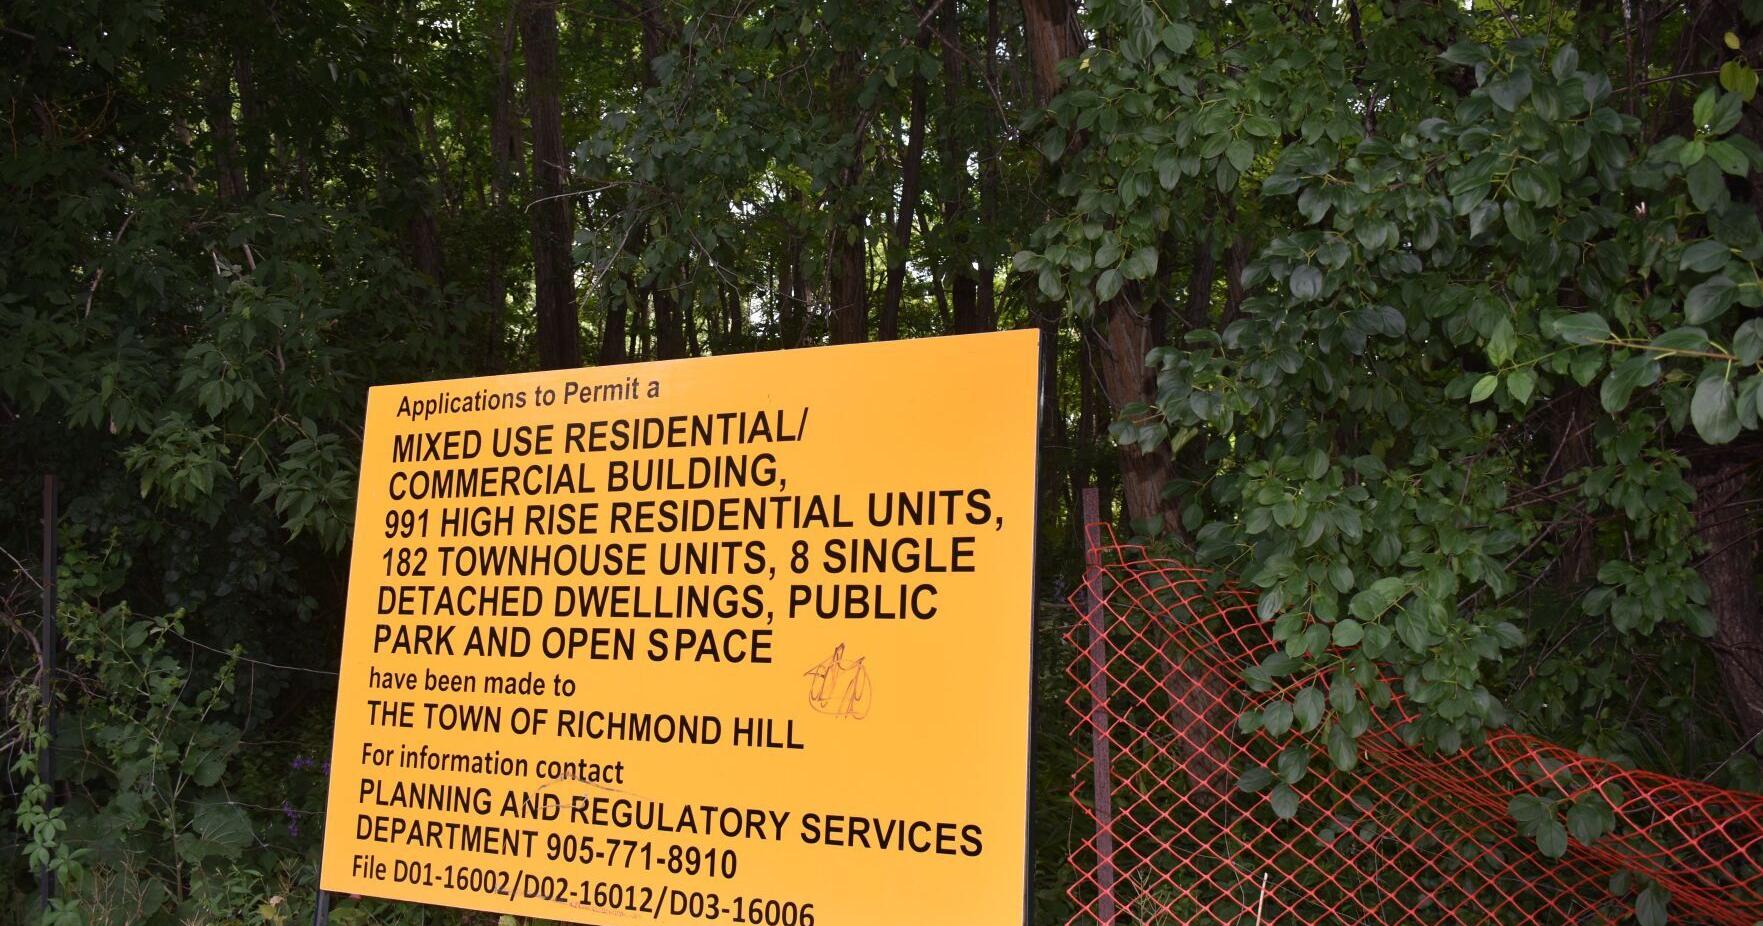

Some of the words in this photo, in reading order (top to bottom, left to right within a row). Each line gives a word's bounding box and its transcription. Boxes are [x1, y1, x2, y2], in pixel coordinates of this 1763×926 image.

[396, 391, 527, 422] Applications
[534, 386, 556, 407] to
[564, 377, 640, 405] Permit
[647, 380, 660, 399] a
[392, 429, 482, 463] MIXED
[492, 424, 554, 458] USE
[564, 407, 809, 454] RESIDENTIAL/
[389, 462, 596, 501] COMMERCIAL
[607, 452, 786, 493] BUILDING,
[384, 508, 429, 539] 991
[440, 505, 514, 538] HIGH
[524, 502, 599, 536] RISE
[610, 494, 854, 534] RESIDENTIAL
[868, 488, 1003, 532] UNITS,
[383, 546, 428, 577] 182
[437, 543, 647, 577] TOWNHOUSE
[659, 540, 776, 581] UNITS,
[790, 539, 809, 574] 8
[823, 536, 976, 574] SINGLE
[377, 585, 543, 617] DETACHED
[554, 584, 774, 625] DWELLINGS,
[789, 583, 938, 620] PUBLIC
[373, 624, 456, 656] PARK
[463, 625, 531, 658] AND
[542, 626, 635, 661] OPEN
[647, 628, 773, 664] SPACE
[369, 666, 418, 690] have
[424, 668, 476, 693] been
[484, 671, 546, 696] made
[553, 674, 576, 697] to
[367, 700, 415, 728] THE
[423, 703, 502, 733] TOWN
[510, 707, 548, 736] OF
[557, 709, 722, 745] RICHMOND
[733, 717, 804, 750] HILL
[361, 742, 395, 767] For
[400, 744, 528, 777] information
[535, 758, 625, 785] contact
[359, 778, 492, 816] PLANNING
[499, 790, 561, 821] AND
[570, 795, 791, 841] REGULATORY
[800, 812, 983, 857] SERVICES
[356, 814, 539, 860] DEPARTMENT
[546, 832, 737, 879] 905-771-8910
[352, 854, 387, 881] File
[393, 858, 815, 926] D01-16002/D02-16012/D03-16006
